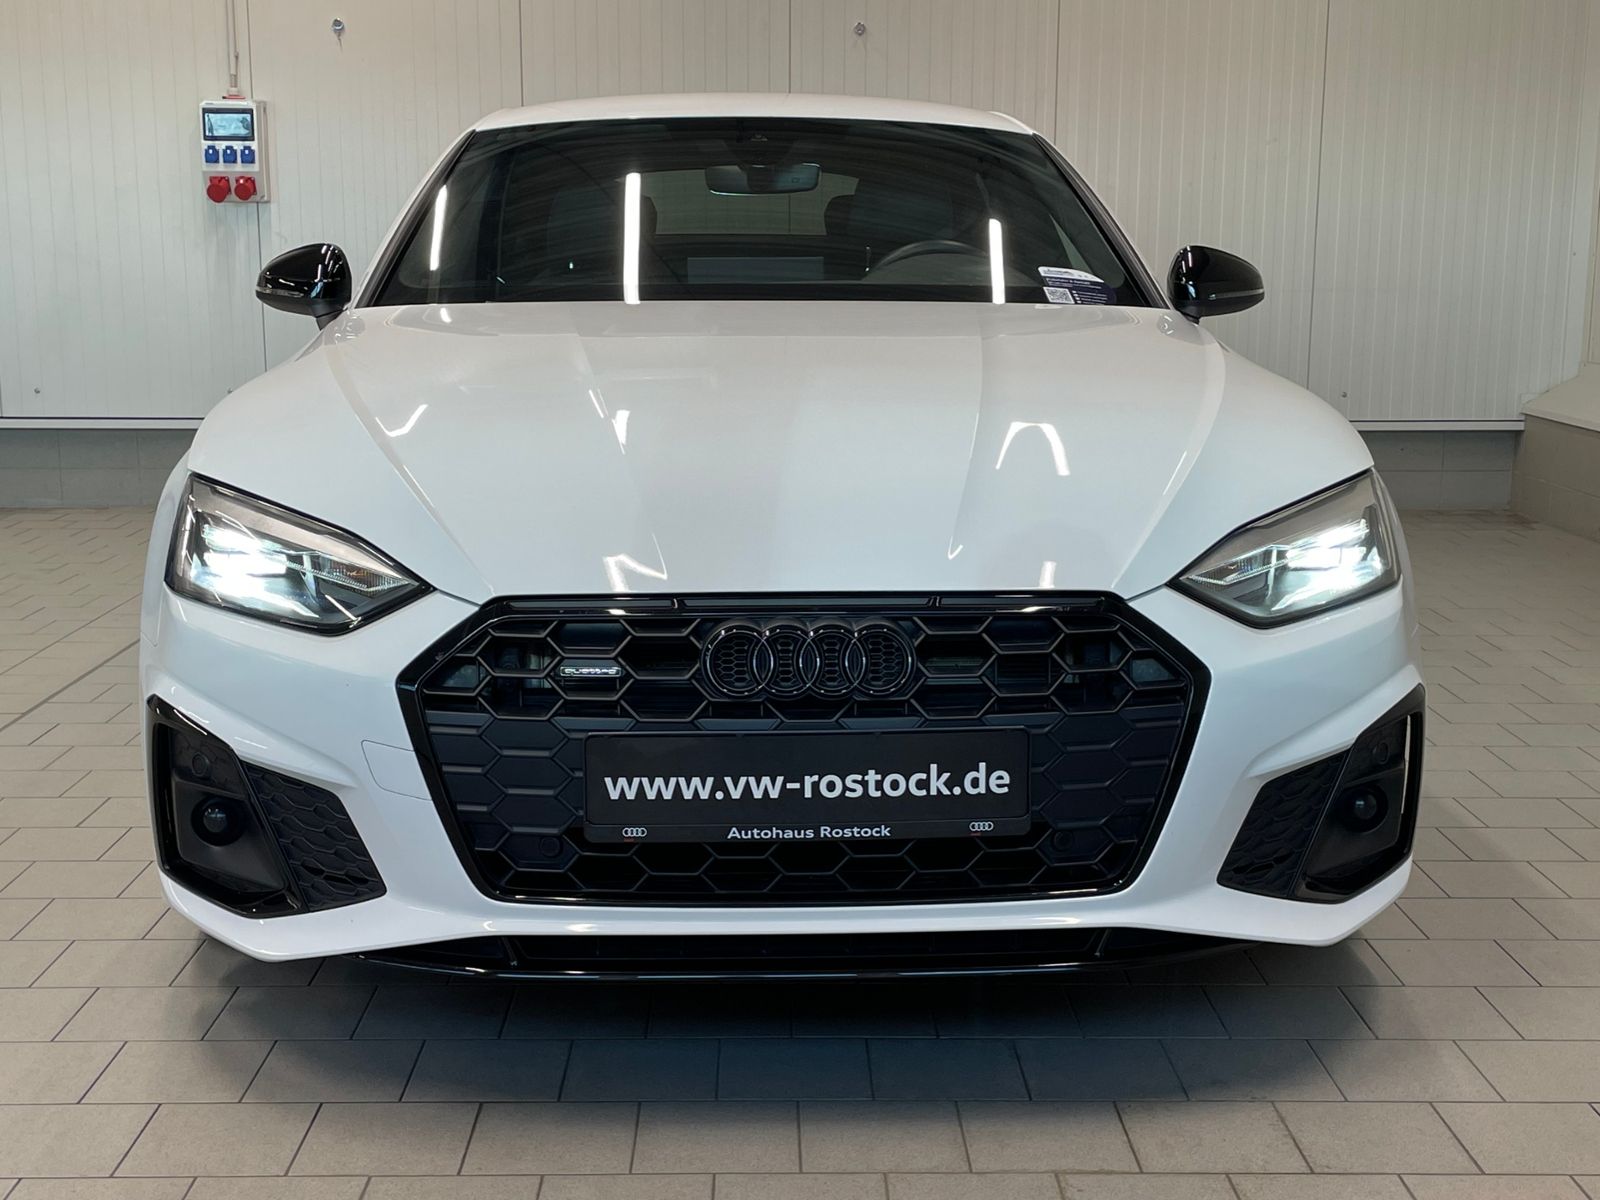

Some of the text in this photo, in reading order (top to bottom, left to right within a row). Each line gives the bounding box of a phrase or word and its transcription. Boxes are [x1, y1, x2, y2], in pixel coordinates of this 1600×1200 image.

[604, 762, 1011, 800] www.vw-rostock.de
[727, 824, 891, 839] Autohaus Rostock
